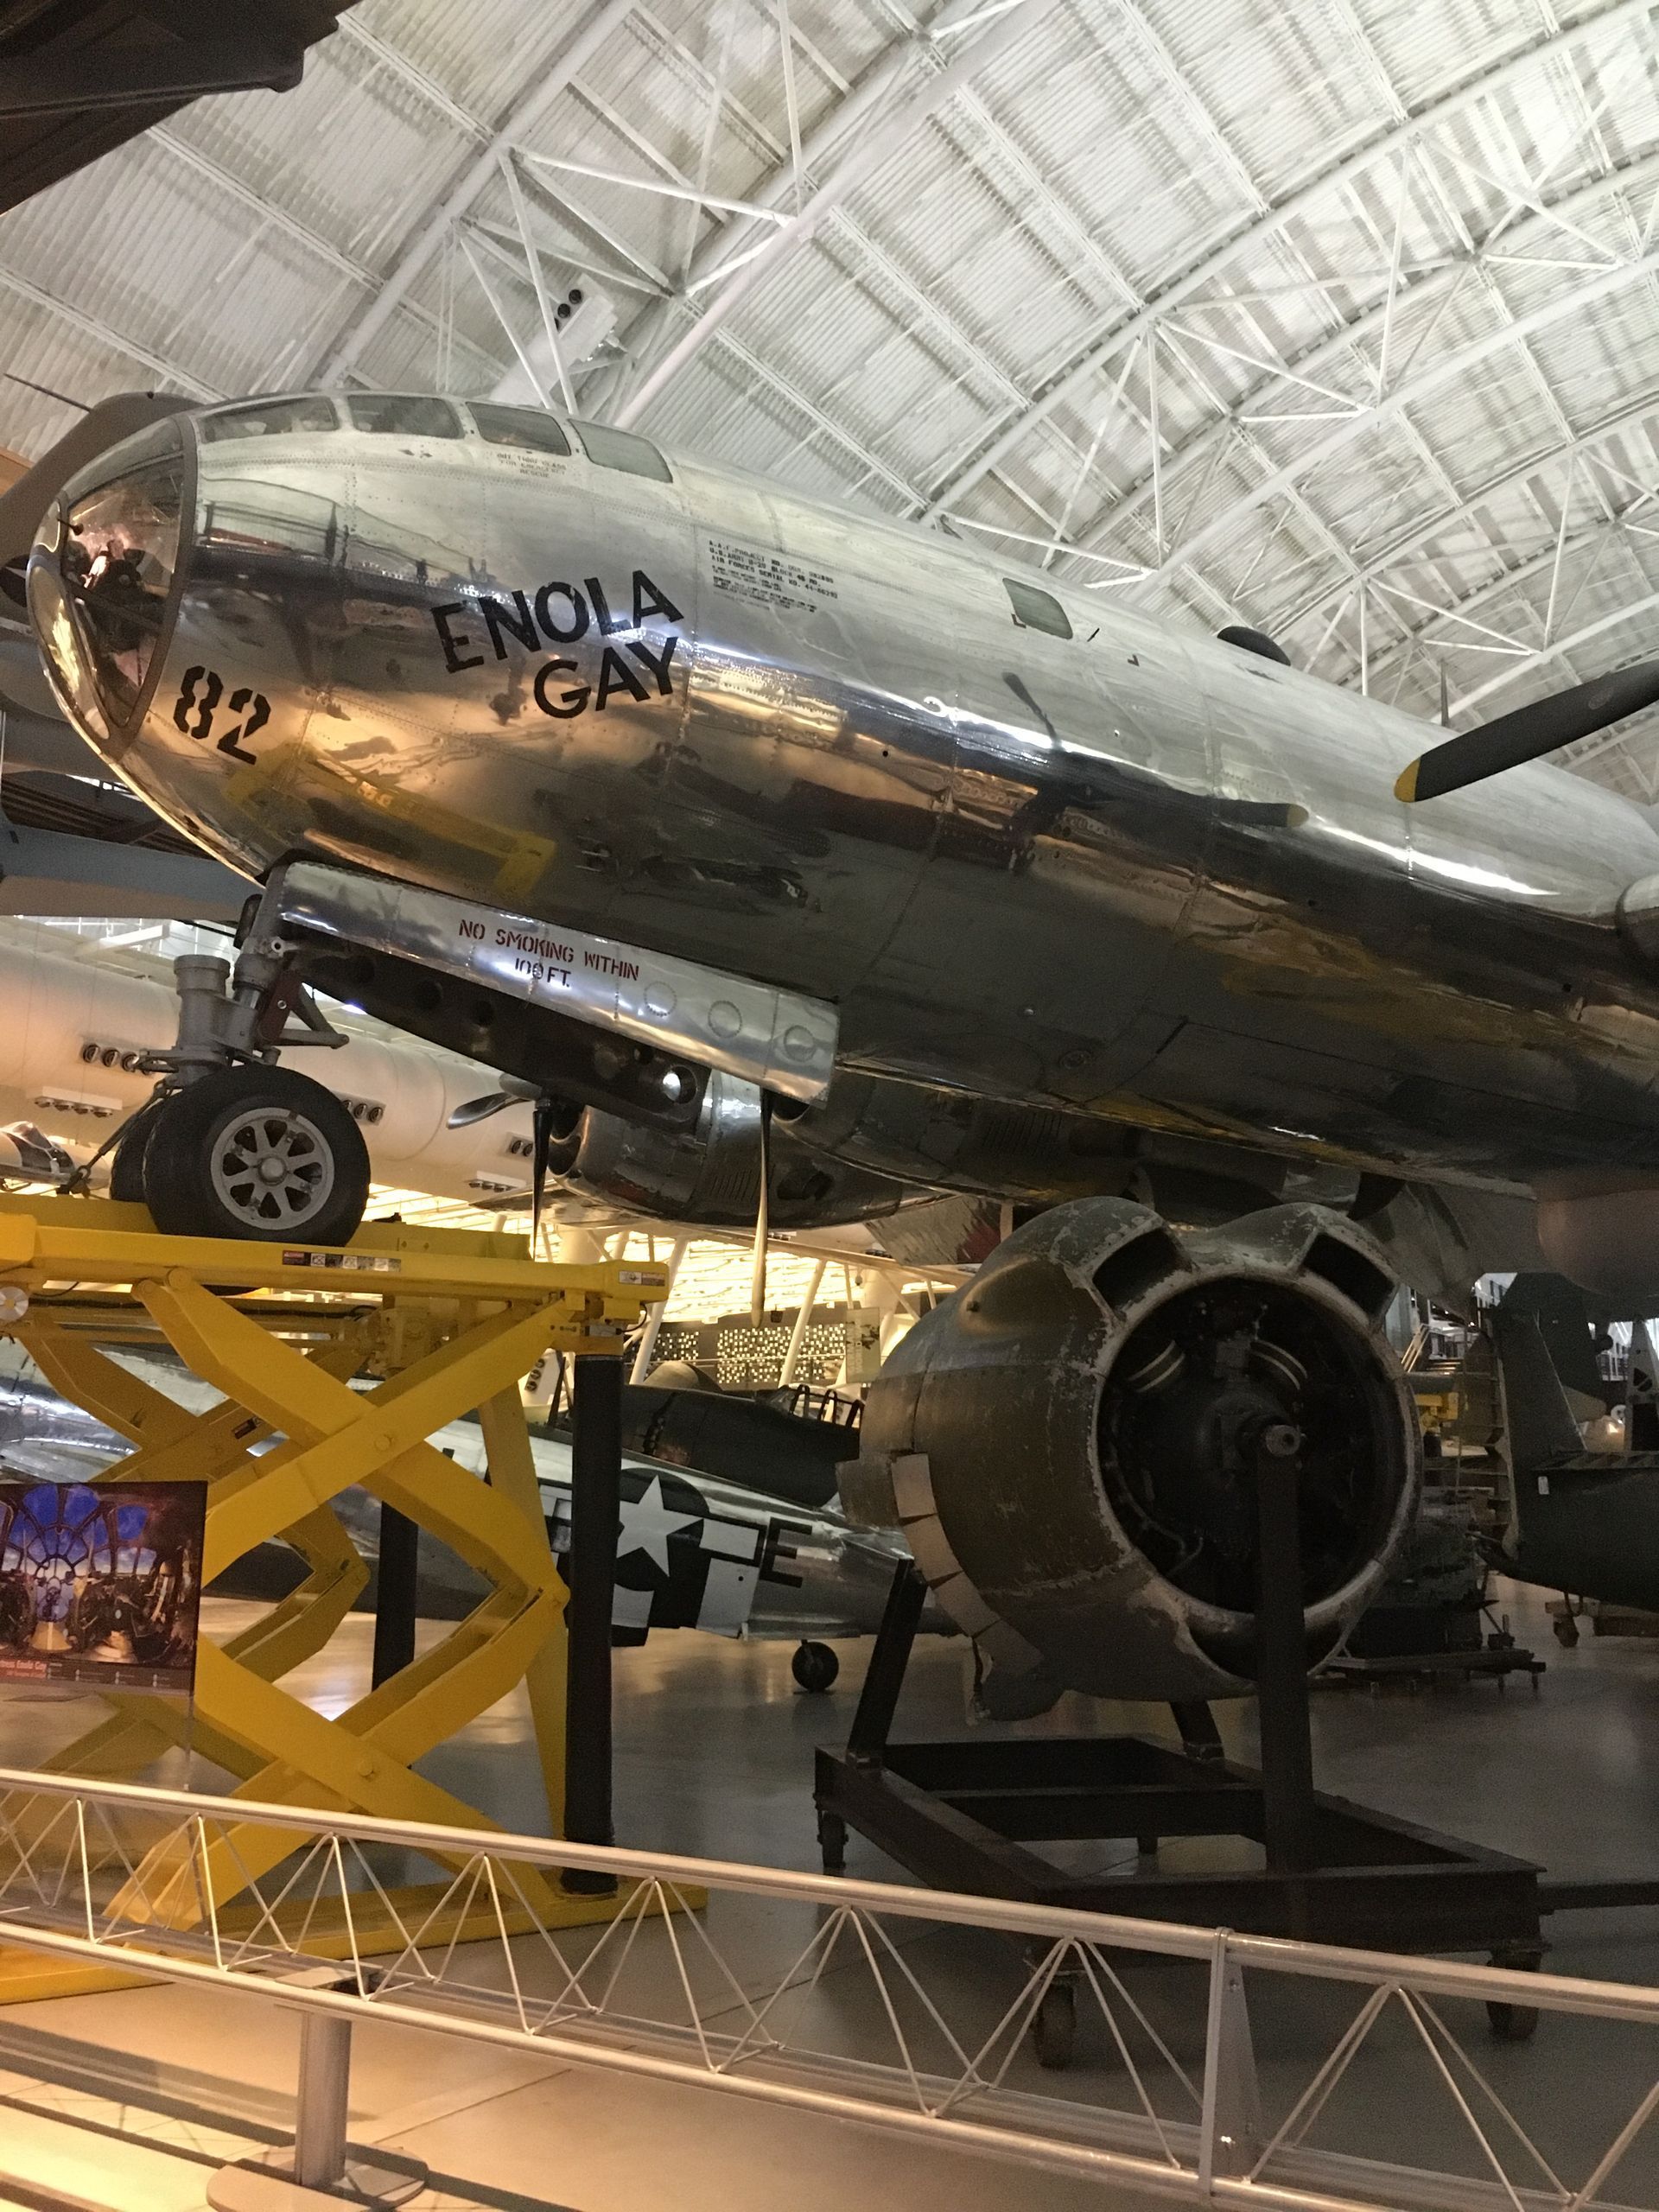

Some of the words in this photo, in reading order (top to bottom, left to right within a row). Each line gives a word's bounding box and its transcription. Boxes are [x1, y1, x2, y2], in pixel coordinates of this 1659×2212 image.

[759, 569, 785, 582] SERIAL
[431, 569, 684, 673] ENOLA
[534, 636, 678, 719] GAY
[173, 665, 271, 766] 82
[459, 919, 486, 940] NO
[495, 928, 575, 963] SMOKING
[584, 950, 639, 982] WITHIN
[515, 957, 543, 980] 100
[547, 966, 571, 988] FT.
